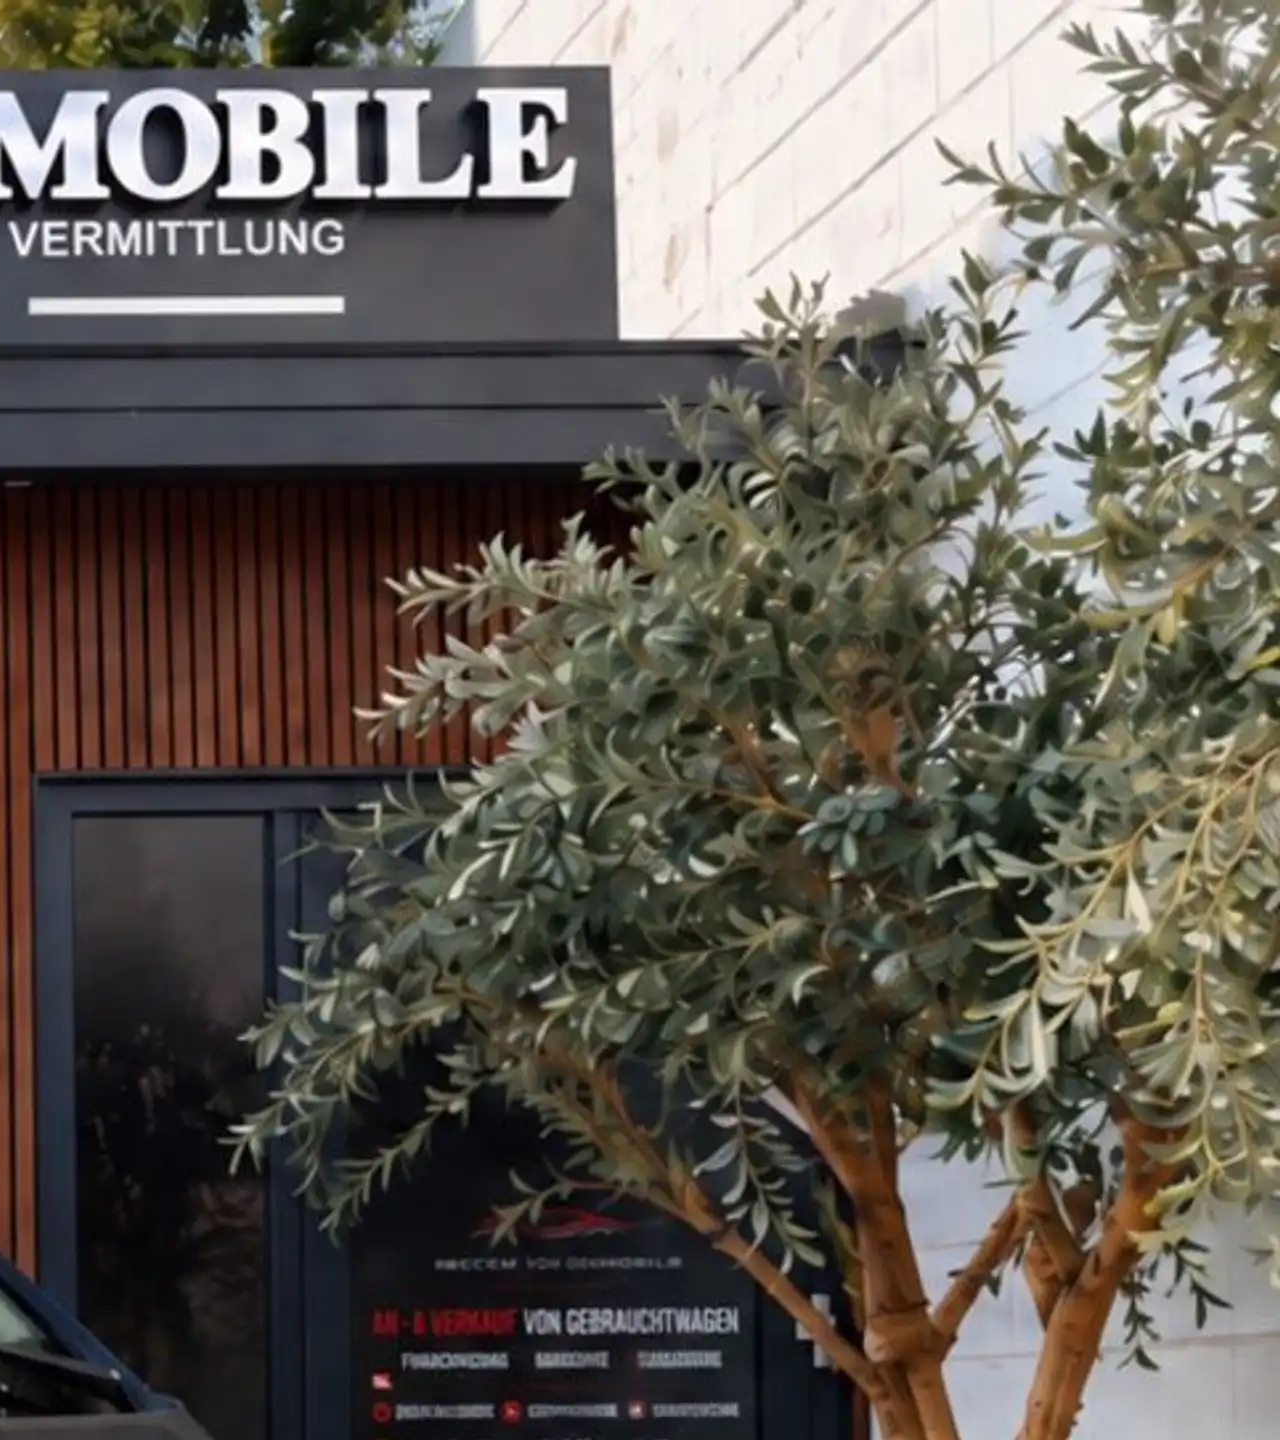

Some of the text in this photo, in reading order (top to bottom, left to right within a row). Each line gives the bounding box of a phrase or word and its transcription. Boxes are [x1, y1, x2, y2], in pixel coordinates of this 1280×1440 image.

[8, 219, 346, 258] VERMITTLUNG
[523, 1307, 562, 1334] VON
[566, 1306, 740, 1335] GEBRAUCHTWAGEN
